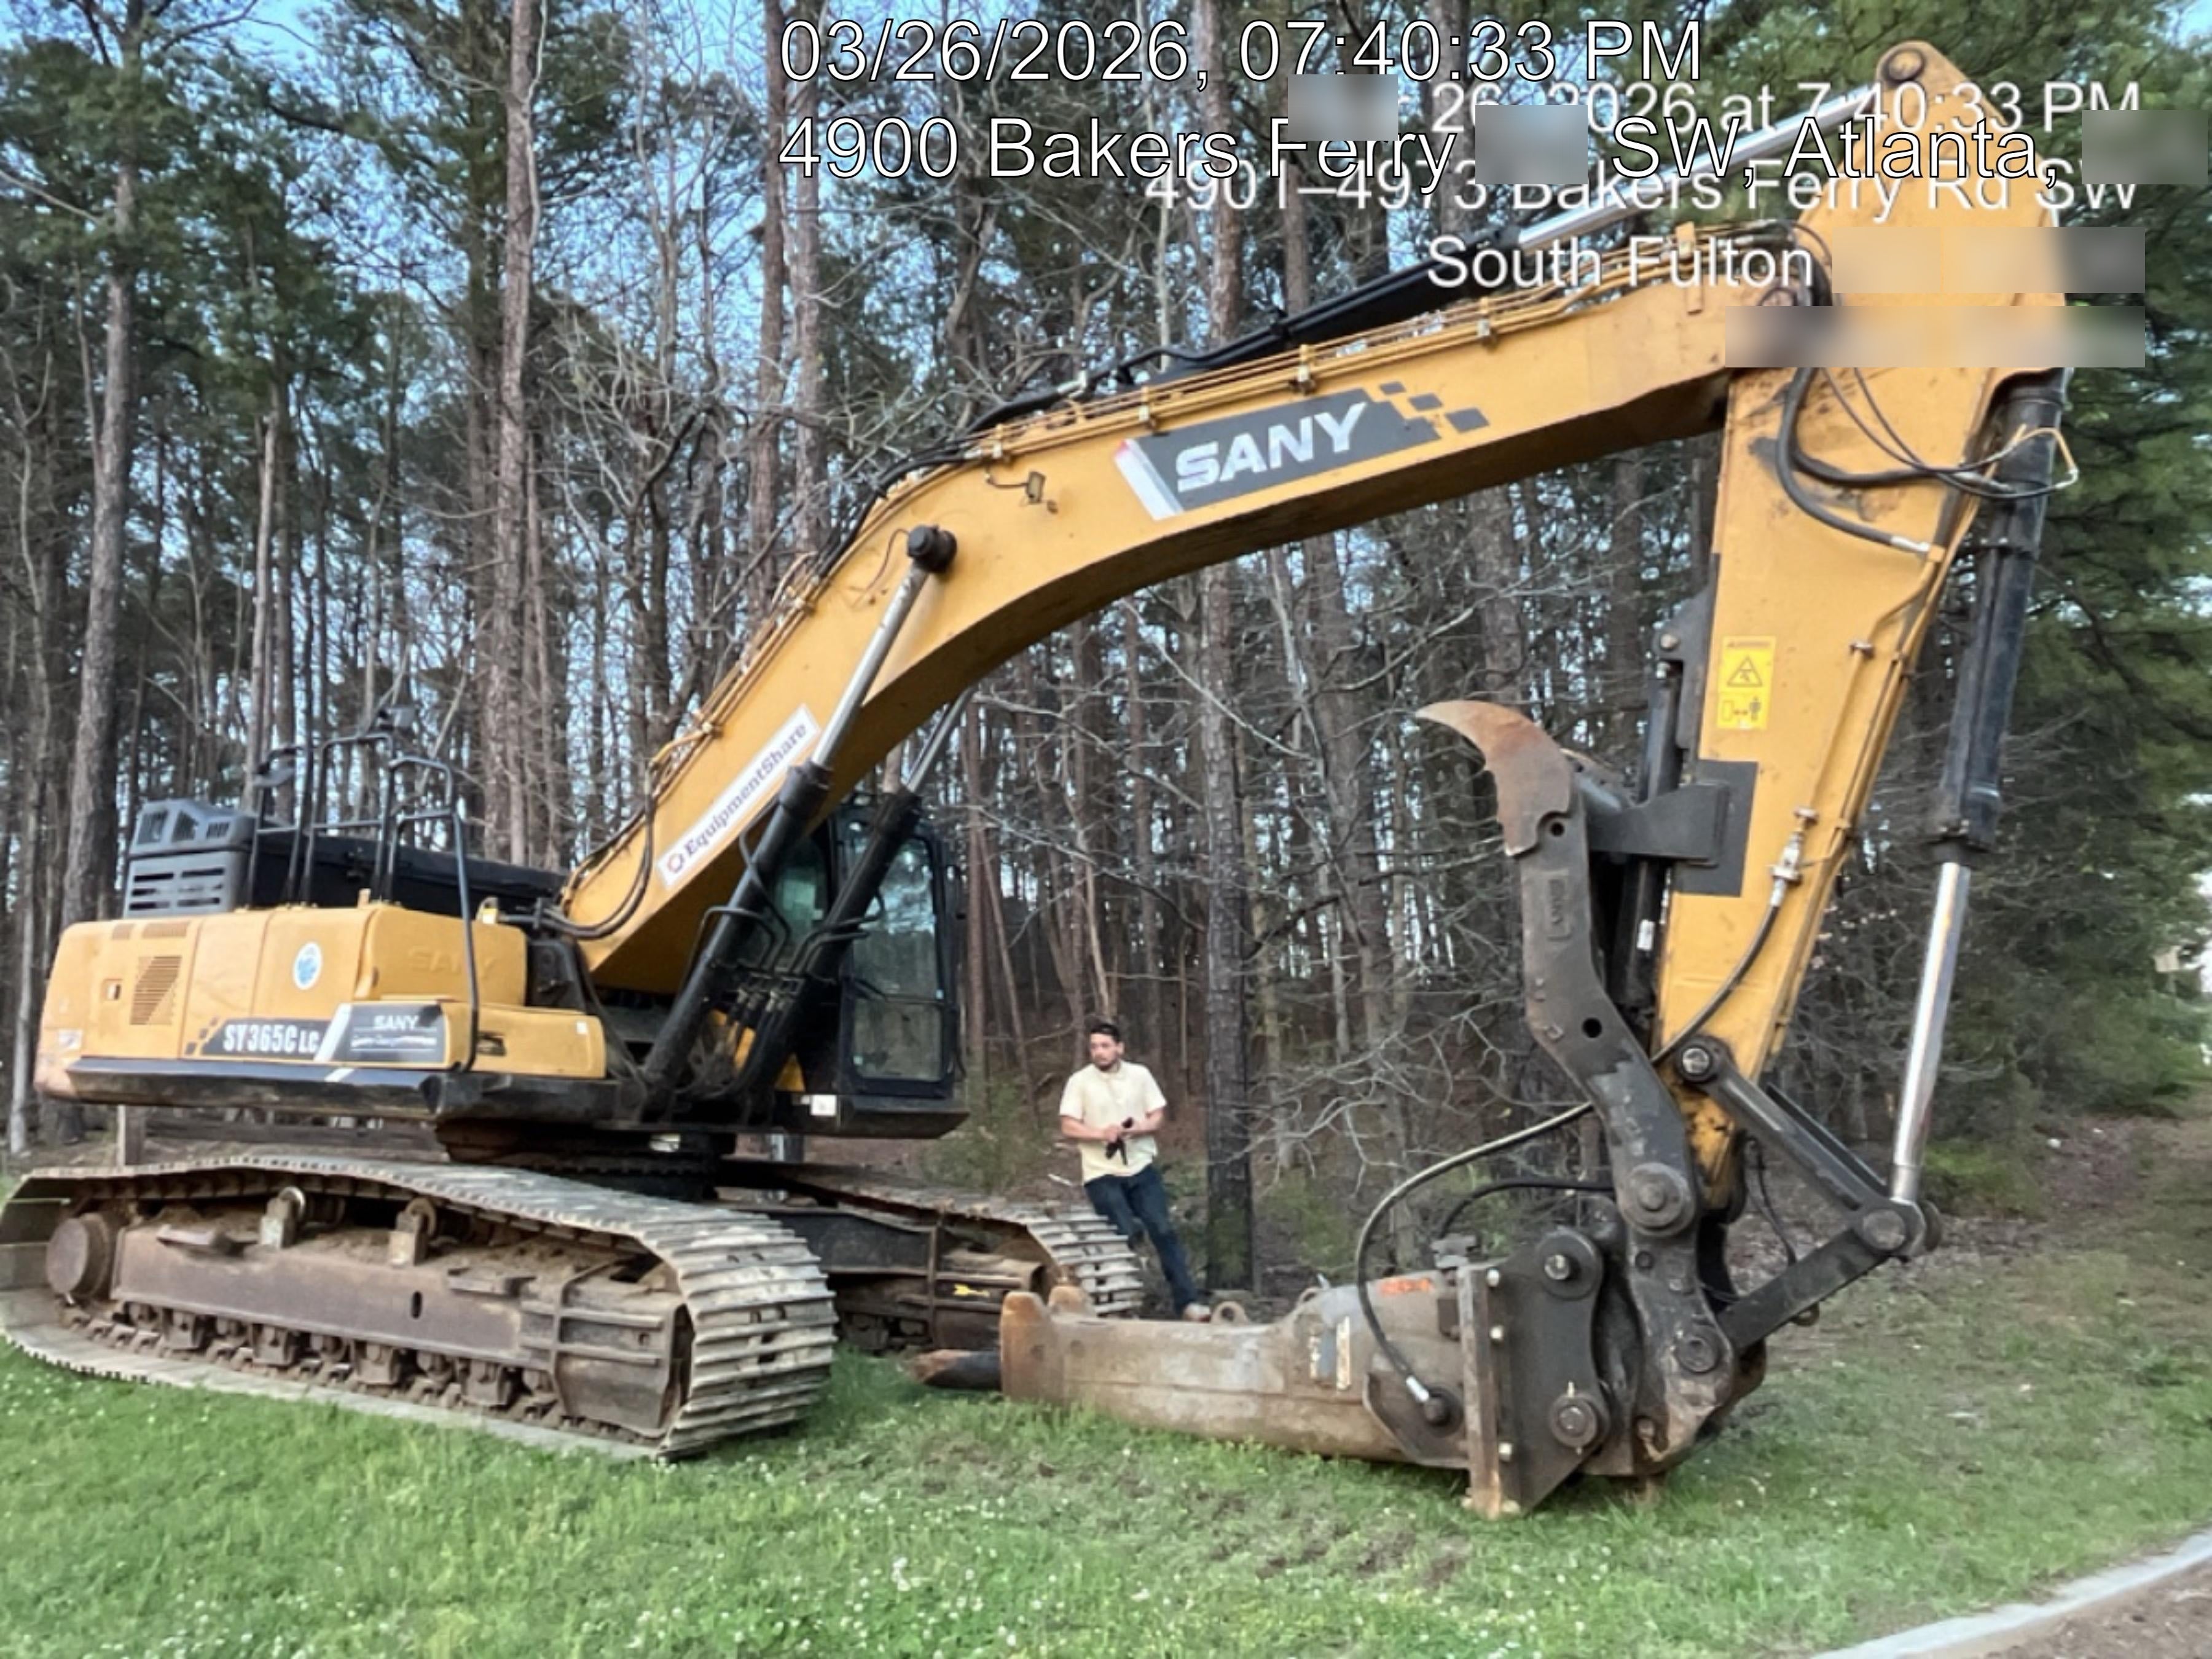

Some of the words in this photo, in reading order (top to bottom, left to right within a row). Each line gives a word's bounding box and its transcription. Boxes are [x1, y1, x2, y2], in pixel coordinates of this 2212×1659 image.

[1175, 401, 1367, 493] SANY
[683, 723, 807, 857] EquipmentShare
[374, 1014, 419, 1030] SANY
